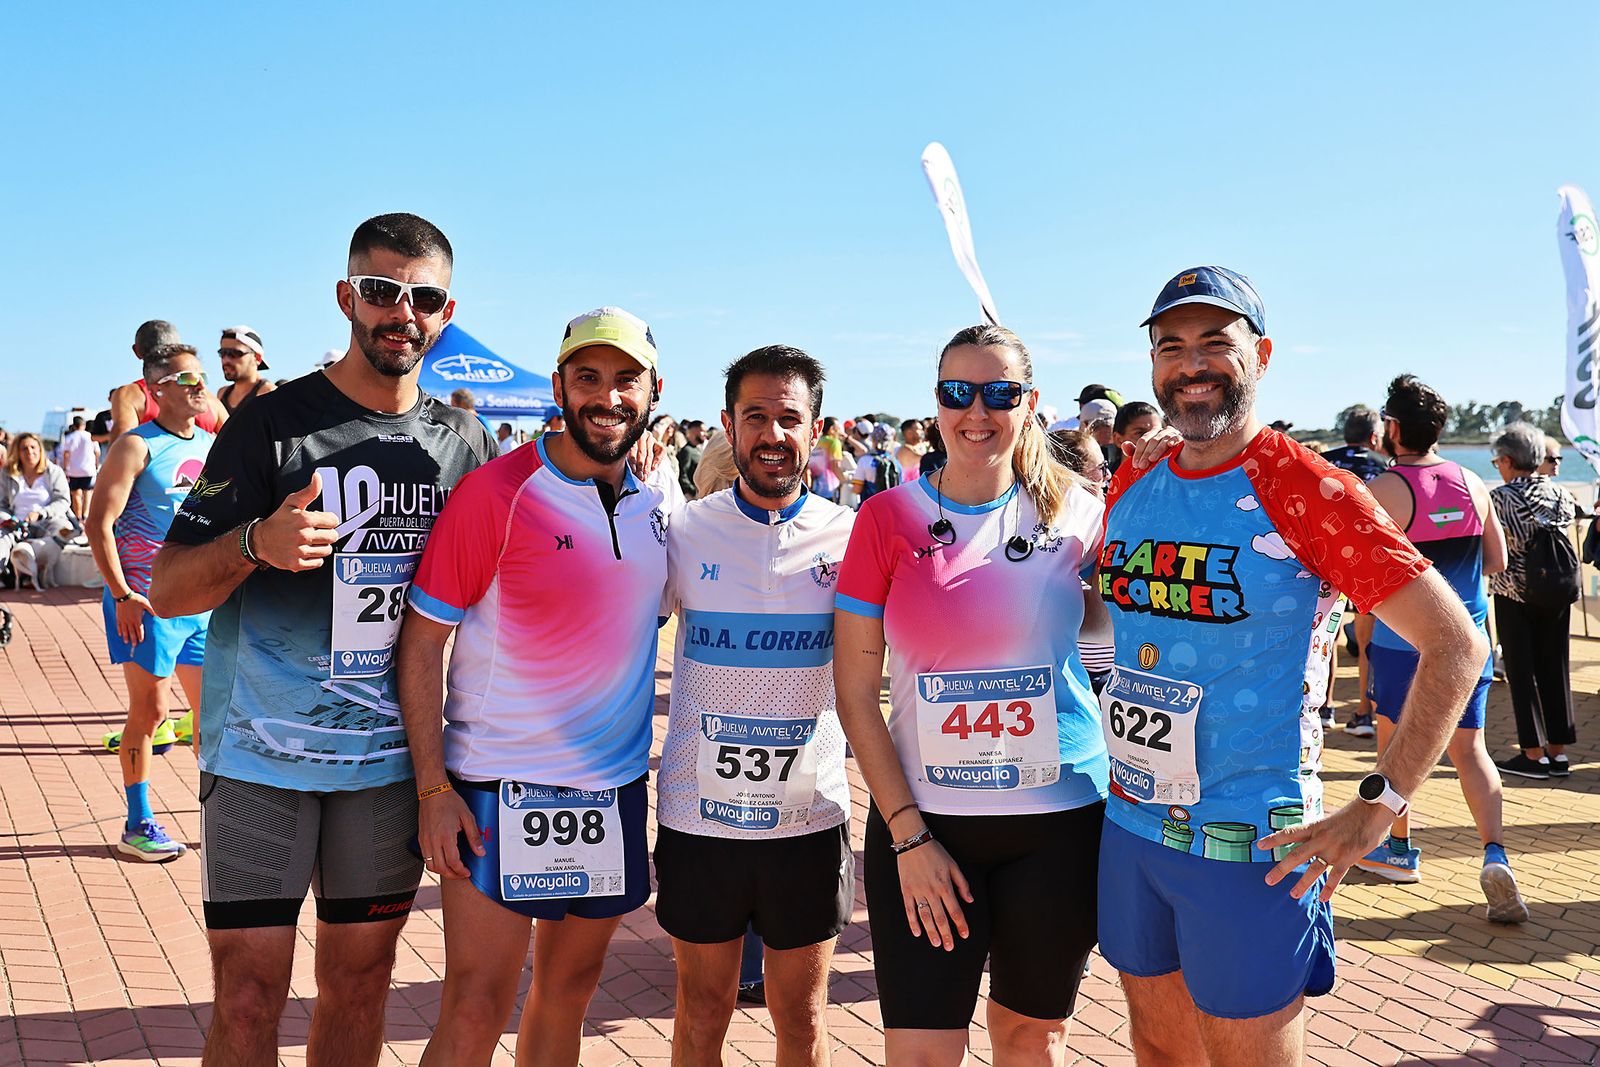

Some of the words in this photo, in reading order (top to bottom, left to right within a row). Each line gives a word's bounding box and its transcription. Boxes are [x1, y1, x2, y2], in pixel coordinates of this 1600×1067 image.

[380, 517, 404, 528] PUERTA
[406, 518, 419, 529] DEL
[361, 563, 391, 573] HUELVA
[1123, 541, 1236, 585] ARTE
[1112, 576, 1243, 617] CORRER
[943, 679, 974, 692] HUELVA
[977, 679, 1020, 691] AVATEL
[1020, 674, 1046, 691] '24
[1132, 682, 1166, 699] AVATEL
[941, 701, 1035, 740] 443
[1109, 700, 1172, 753] 622
[720, 722, 748, 734] HUELVA
[751, 726, 791, 737] AVATEL
[791, 725, 811, 740] '24
[715, 745, 799, 781] 537
[946, 766, 1010, 782] Wayalia
[1115, 762, 1150, 790] Wayalia
[525, 788, 555, 799] HUELVA
[716, 803, 771, 822] Wayalia
[523, 810, 605, 846] 998
[1386, 856, 1409, 866] HOKA
[523, 873, 581, 891] Wayalia
